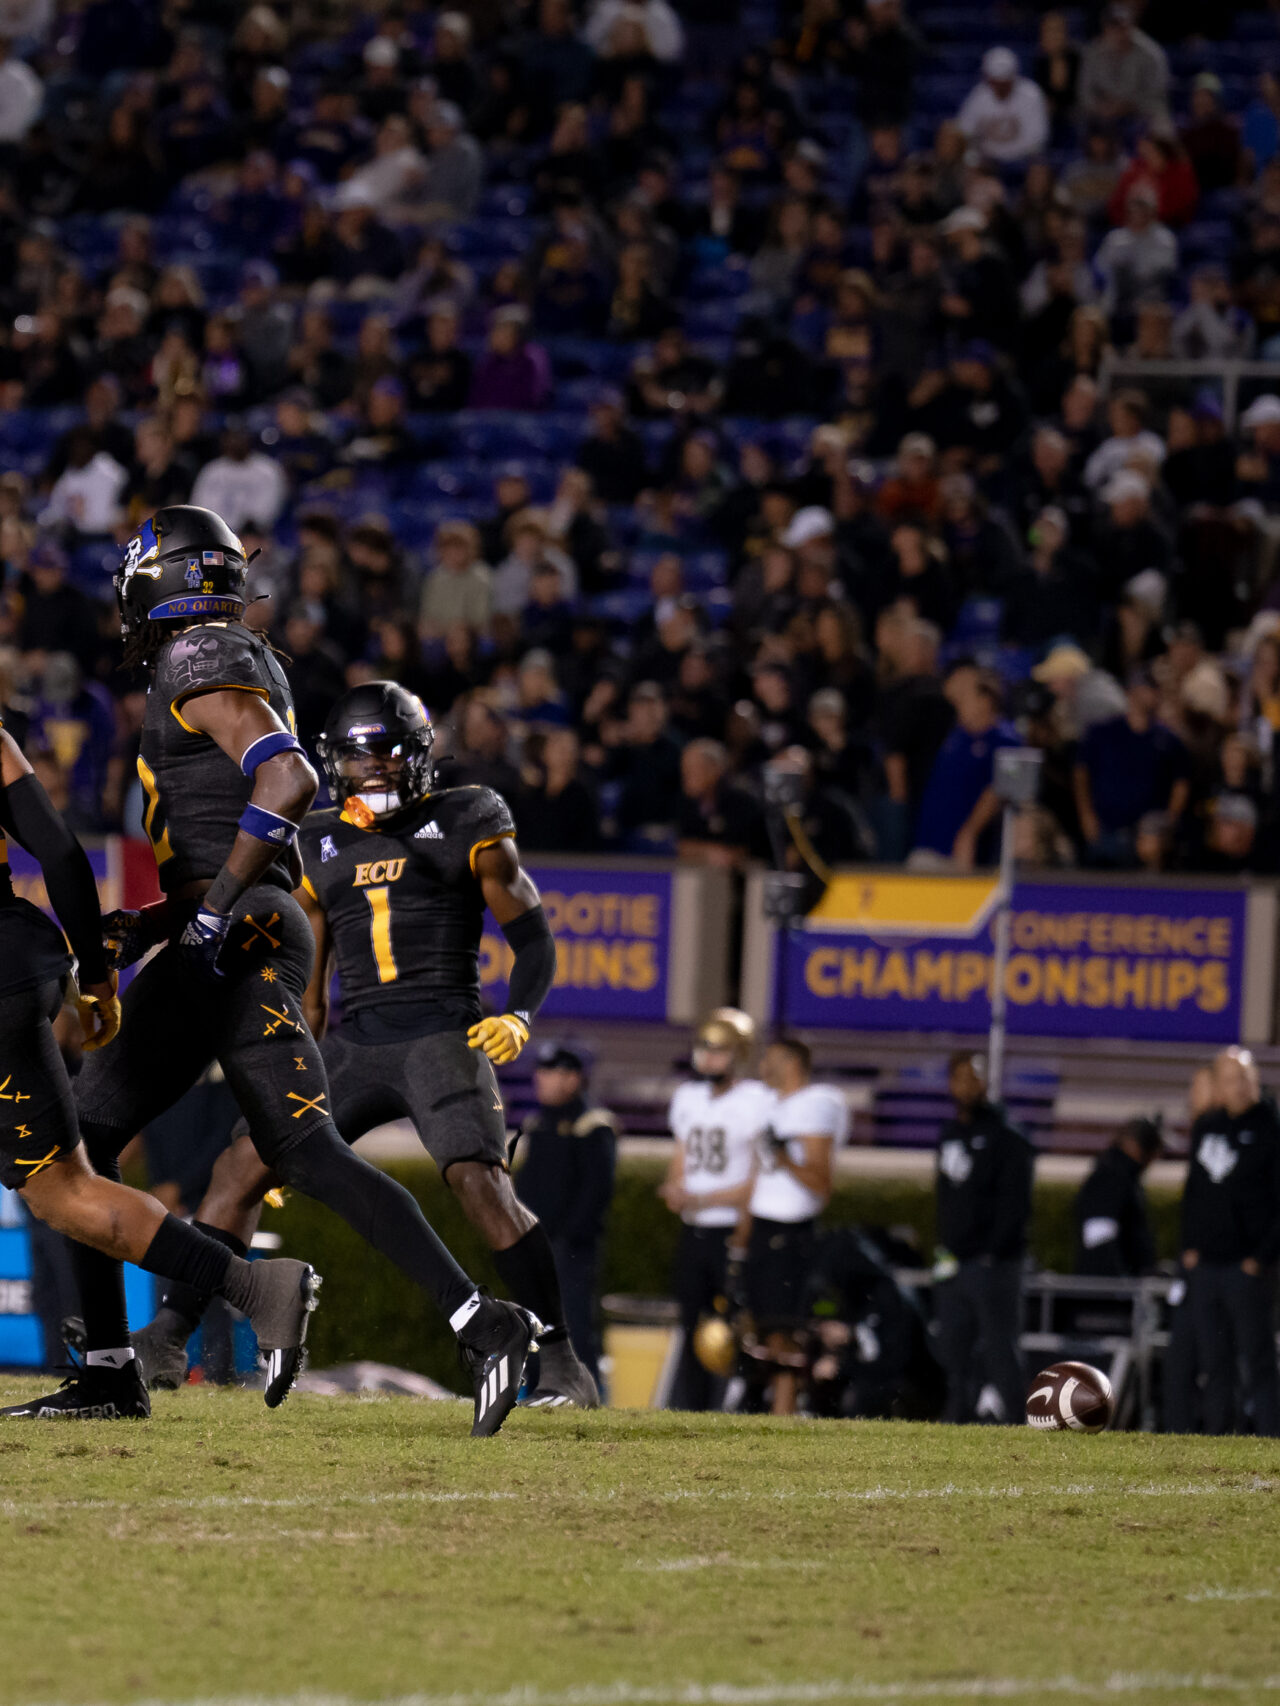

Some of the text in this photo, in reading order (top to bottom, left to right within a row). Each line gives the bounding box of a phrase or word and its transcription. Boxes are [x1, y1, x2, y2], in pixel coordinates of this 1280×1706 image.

[202, 581, 214, 593] 32
[168, 602, 187, 614] NO
[352, 857, 407, 887] ECU
[540, 891, 659, 938] OOTIE
[363, 885, 398, 985] 1
